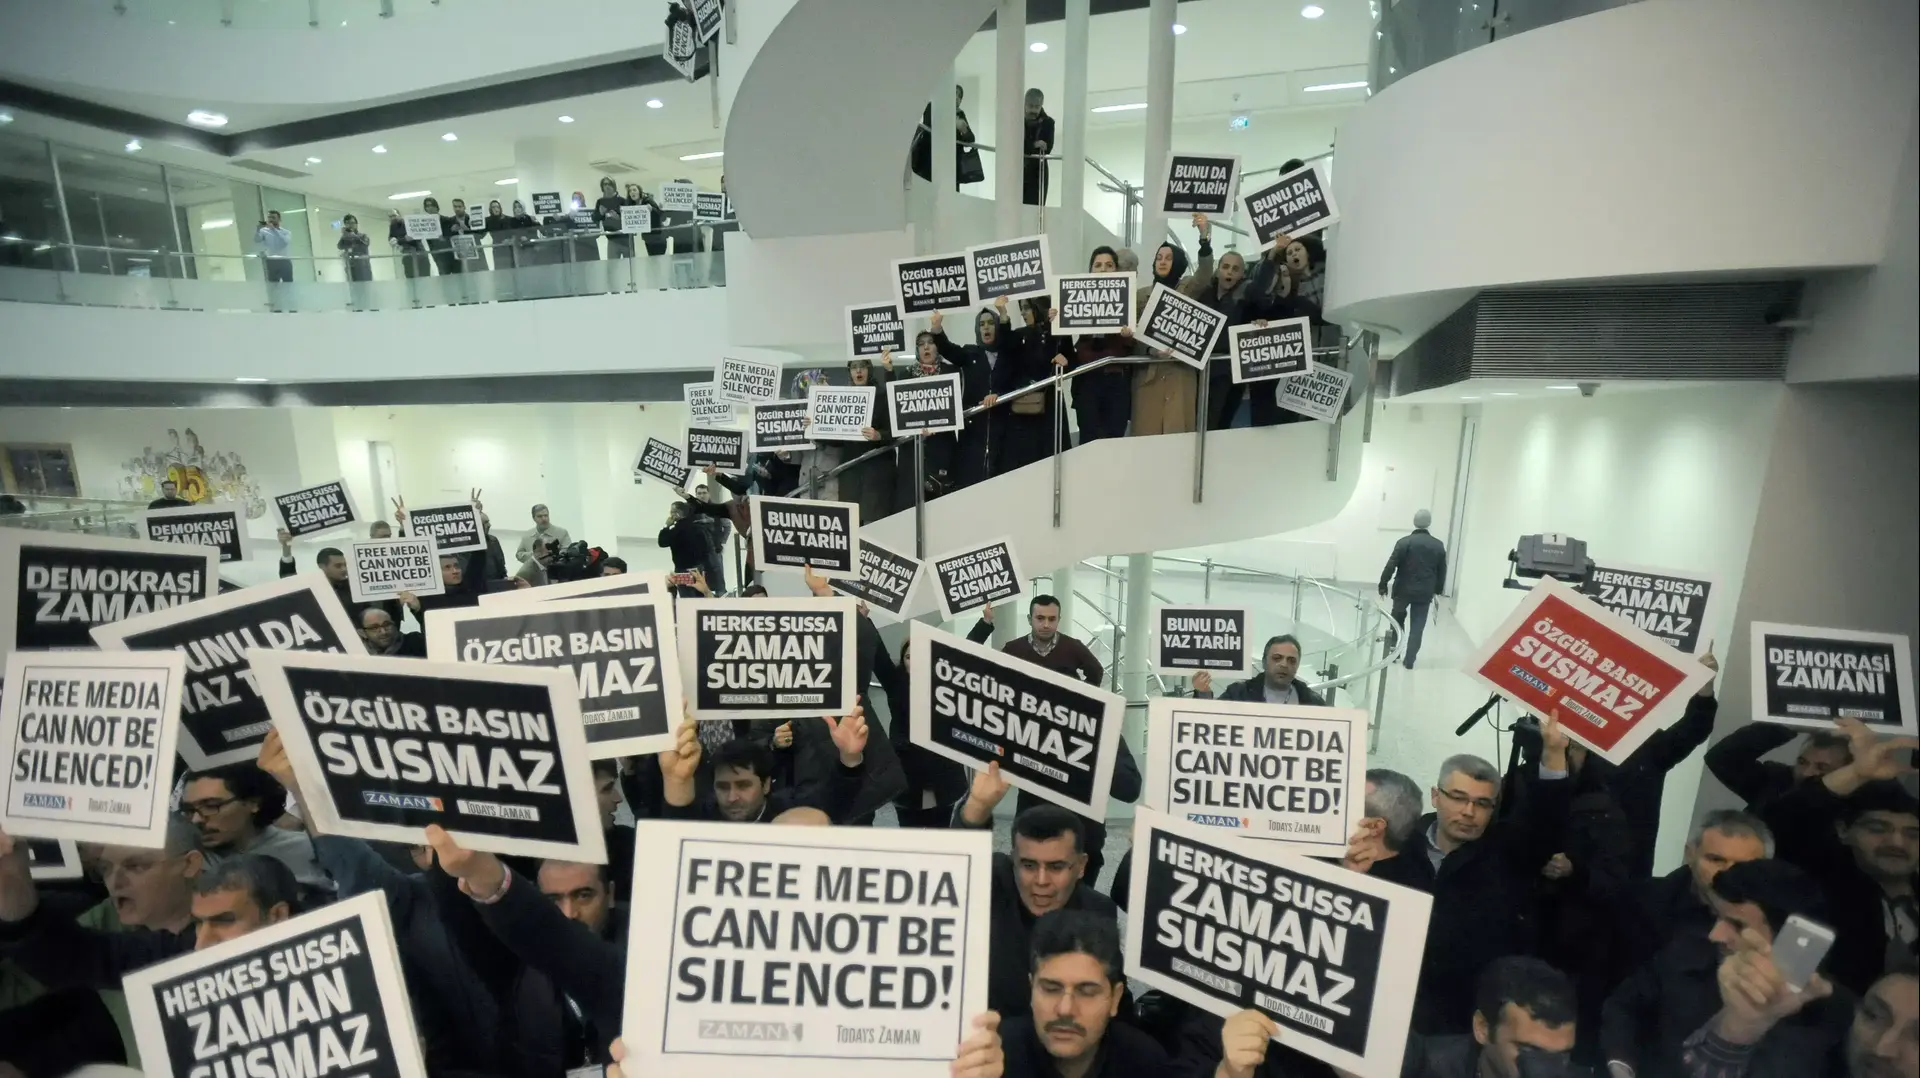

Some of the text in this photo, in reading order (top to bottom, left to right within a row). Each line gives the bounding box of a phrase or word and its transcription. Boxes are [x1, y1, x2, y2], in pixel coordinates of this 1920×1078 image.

[1175, 165, 1227, 179] BUNU DA
[1170, 180, 1228, 195] YAZ TARİH
[1252, 178, 1314, 213] BUNU DA
[1254, 211, 1280, 228] YAZ
[1280, 190, 1322, 216] TARİH
[976, 248, 1039, 267] ÖZGÜR BASIN
[901, 265, 964, 281] ÖZGÜR BASIN
[978, 260, 1041, 284] SUSMAZ
[903, 277, 966, 297] SUSMAZ
[1062, 279, 1126, 289] HERKES SUSSA
[1068, 290, 1120, 303] ZAMAN
[864, 312, 891, 323] ZAMAN
[1064, 303, 1124, 318] SUSMAZ
[1161, 304, 1208, 336] ZAMAN
[1162, 294, 1216, 326] HERKES SUSSA
[853, 324, 876, 334] SAHİP
[864, 332, 894, 343] ZAMANI
[1152, 316, 1205, 350] SUSMAZ
[1240, 331, 1302, 348] ÖZGÜR BASIN
[1241, 342, 1303, 364] SUSMAZ
[724, 371, 774, 387] CAN NOT BE
[725, 362, 775, 377] FREE MEDIA
[1316, 372, 1343, 387] MEDIA
[723, 381, 773, 397] SILENCED!
[896, 386, 952, 401] DEMOKRASİ
[1285, 384, 1337, 407] SILENCED!
[1290, 376, 1340, 397] CAN NOT BE
[691, 398, 704, 406] CAN
[692, 404, 730, 415] SILENCED!
[816, 405, 866, 414] CAN NOT BE
[817, 395, 866, 404] FREE MEDIA
[900, 398, 950, 413] ZAMANI
[757, 411, 783, 420] ÖZGÜR
[815, 415, 864, 425] SILENCED!
[649, 440, 674, 454] HERKES
[690, 434, 740, 445] DEMOKRASİ
[692, 443, 737, 455] ZAMANI
[643, 456, 686, 480] SUSMAZ
[278, 485, 340, 505] HERKES SUSSA
[287, 493, 339, 515] ZAMAN
[289, 504, 347, 527] SUSMAZ
[414, 511, 473, 524] ÖZGÜR BASIN
[768, 511, 843, 532] BUNU DA
[152, 518, 234, 536] DEMOKRASİ
[415, 521, 476, 537] SUSMAZ
[764, 529, 847, 550] YAZ TARİH
[1552, 534, 1557, 542] 1
[357, 545, 428, 558] FREE MEDIA
[939, 546, 1005, 572] HERKES SUSSA
[359, 556, 430, 570] CAN NOT BE
[881, 559, 913, 580] BASIN
[948, 557, 1003, 585] ZAMAN
[27, 565, 199, 593] DEMOKRASİ
[361, 567, 432, 583] SILENCED!
[1593, 571, 1703, 597] HERKES SUSSA
[949, 571, 1012, 602] SUSMAZ
[1599, 585, 1690, 615] ZAMAN
[702, 616, 838, 632] HERKES SUSSA
[1167, 617, 1237, 633] BUNU DA
[175, 614, 322, 673] UNU DA
[463, 627, 653, 665] ÖZGÜR BASIN
[715, 634, 824, 660] ZAMAN
[1162, 634, 1241, 650] YAZ TARİH
[1534, 617, 1660, 699] ÖZGÜR BASIN
[1769, 648, 1890, 672] DEMOKRASİ
[707, 663, 832, 689] SUSMAZ
[1512, 636, 1644, 720] SUSMAZ
[1512, 666, 1548, 691] ZAMAN
[1777, 666, 1885, 694] ZAMANI
[25, 680, 160, 710] FREE MEDIA
[935, 658, 1097, 737] ÖZGÜR BASIN
[304, 690, 550, 742] ÖZGÜR BASIN
[21, 712, 157, 749] CAN NOT BE
[935, 686, 1093, 772] SUSMAZ
[1177, 722, 1344, 753] FREE MEDIA
[954, 730, 994, 752] ZAMAN
[15, 748, 152, 790] SILENCED!
[317, 732, 561, 795] SUSMAZ
[1175, 749, 1342, 783] CAN NOT BE
[24, 793, 64, 808] ZAMAN
[365, 792, 426, 808] ZAMAN
[1173, 778, 1341, 815] SILENCED!
[498, 805, 531, 819] ZAMAN
[1188, 814, 1237, 827] ZAMAN
[1295, 822, 1321, 834] ZAMAN
[687, 858, 959, 908] FREE MEDIA
[1158, 838, 1373, 931] HERKES SUSSA
[1170, 871, 1347, 967] ZAMAN
[682, 906, 955, 957] CAN NOT BE
[162, 930, 360, 1017] HERKES SUSSA
[1157, 911, 1355, 1016] SUSMAZ
[676, 957, 954, 1010] SILENCED!
[1174, 961, 1227, 990] ZAMAN
[187, 968, 351, 1060] ZAMAN
[1293, 1008, 1326, 1030] ZAMAN
[701, 1022, 783, 1040] ZAMAN
[878, 1025, 921, 1044] ZAMAN
